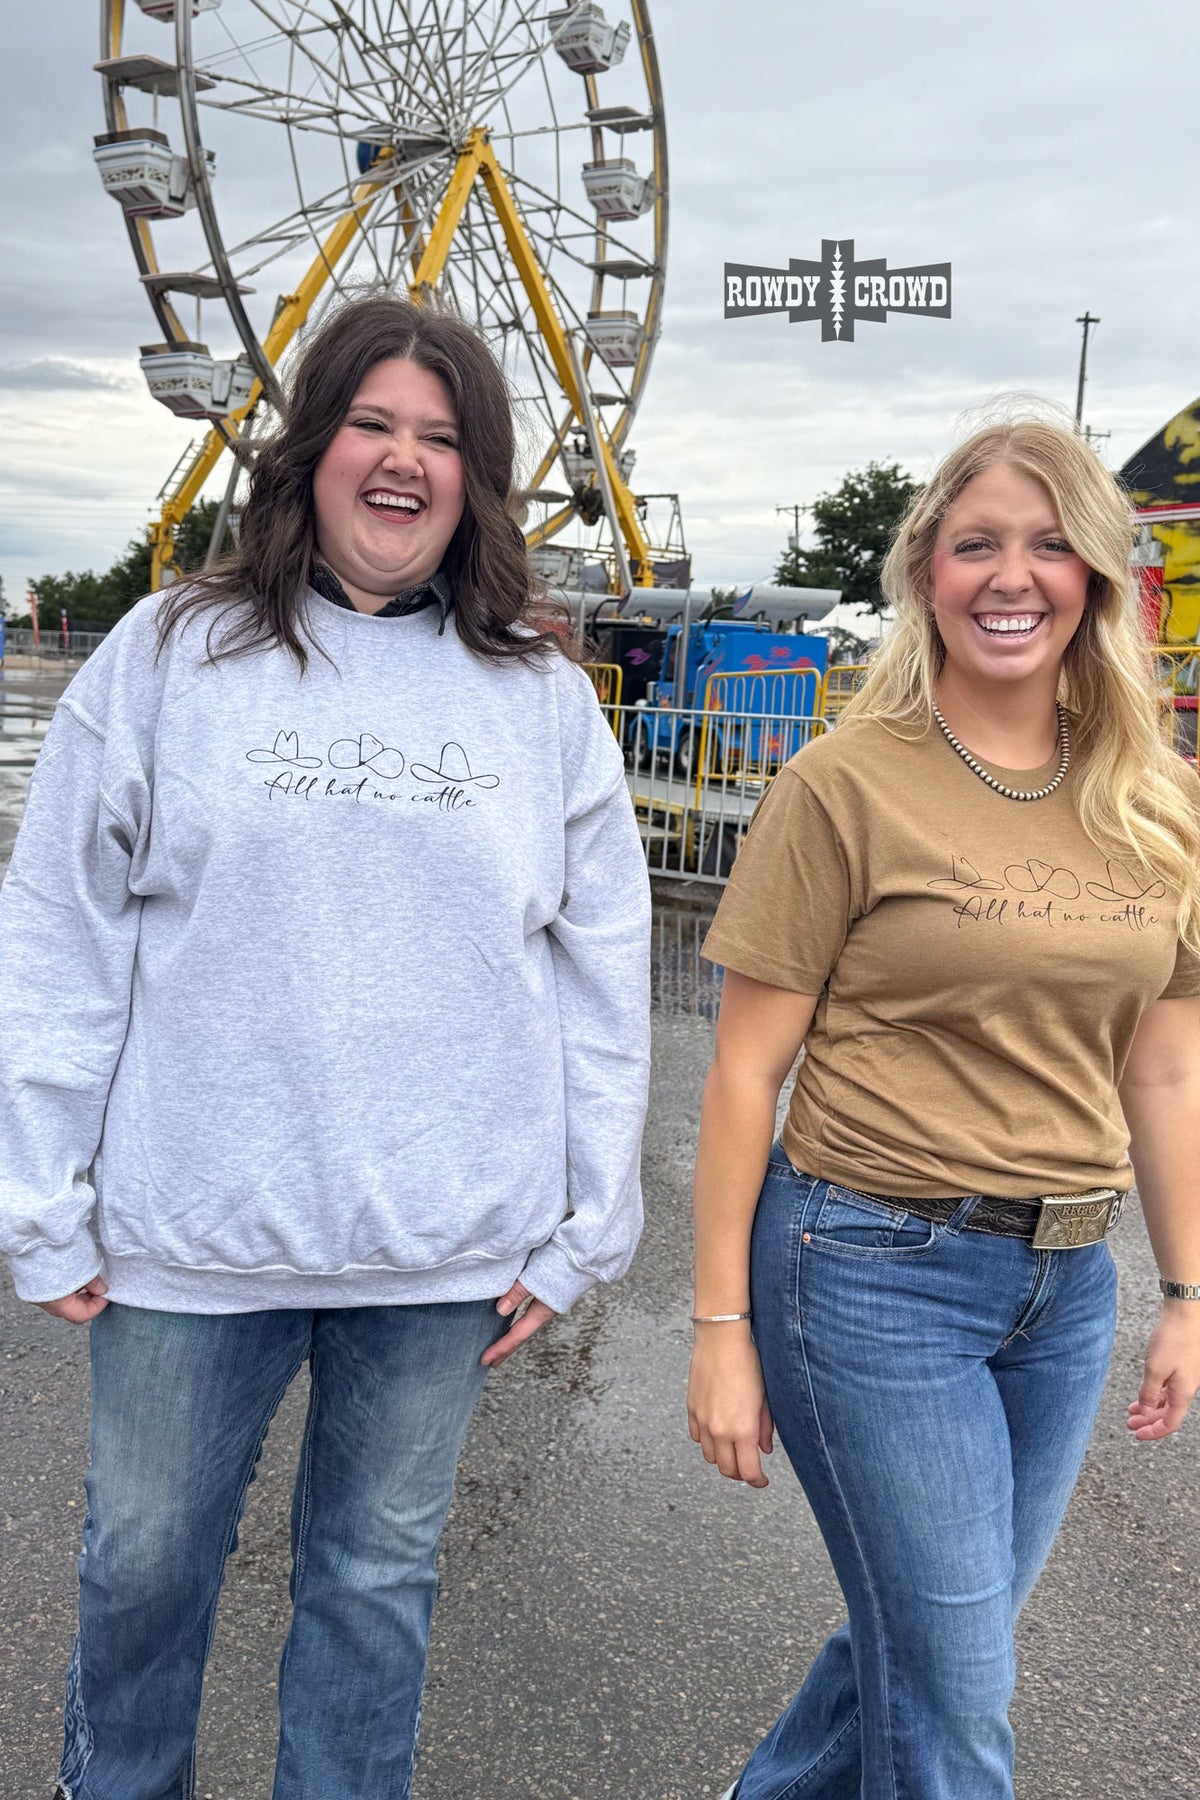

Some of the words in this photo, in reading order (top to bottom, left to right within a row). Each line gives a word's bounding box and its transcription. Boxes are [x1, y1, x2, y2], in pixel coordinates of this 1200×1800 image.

[264, 771, 318, 801] All
[324, 777, 375, 803] hat
[374, 788, 402, 801] no
[411, 786, 478, 813] cattle
[953, 895, 1008, 929] All
[1017, 900, 1063, 928] hat
[1064, 911, 1090, 923] no
[1100, 904, 1160, 932] cattle
